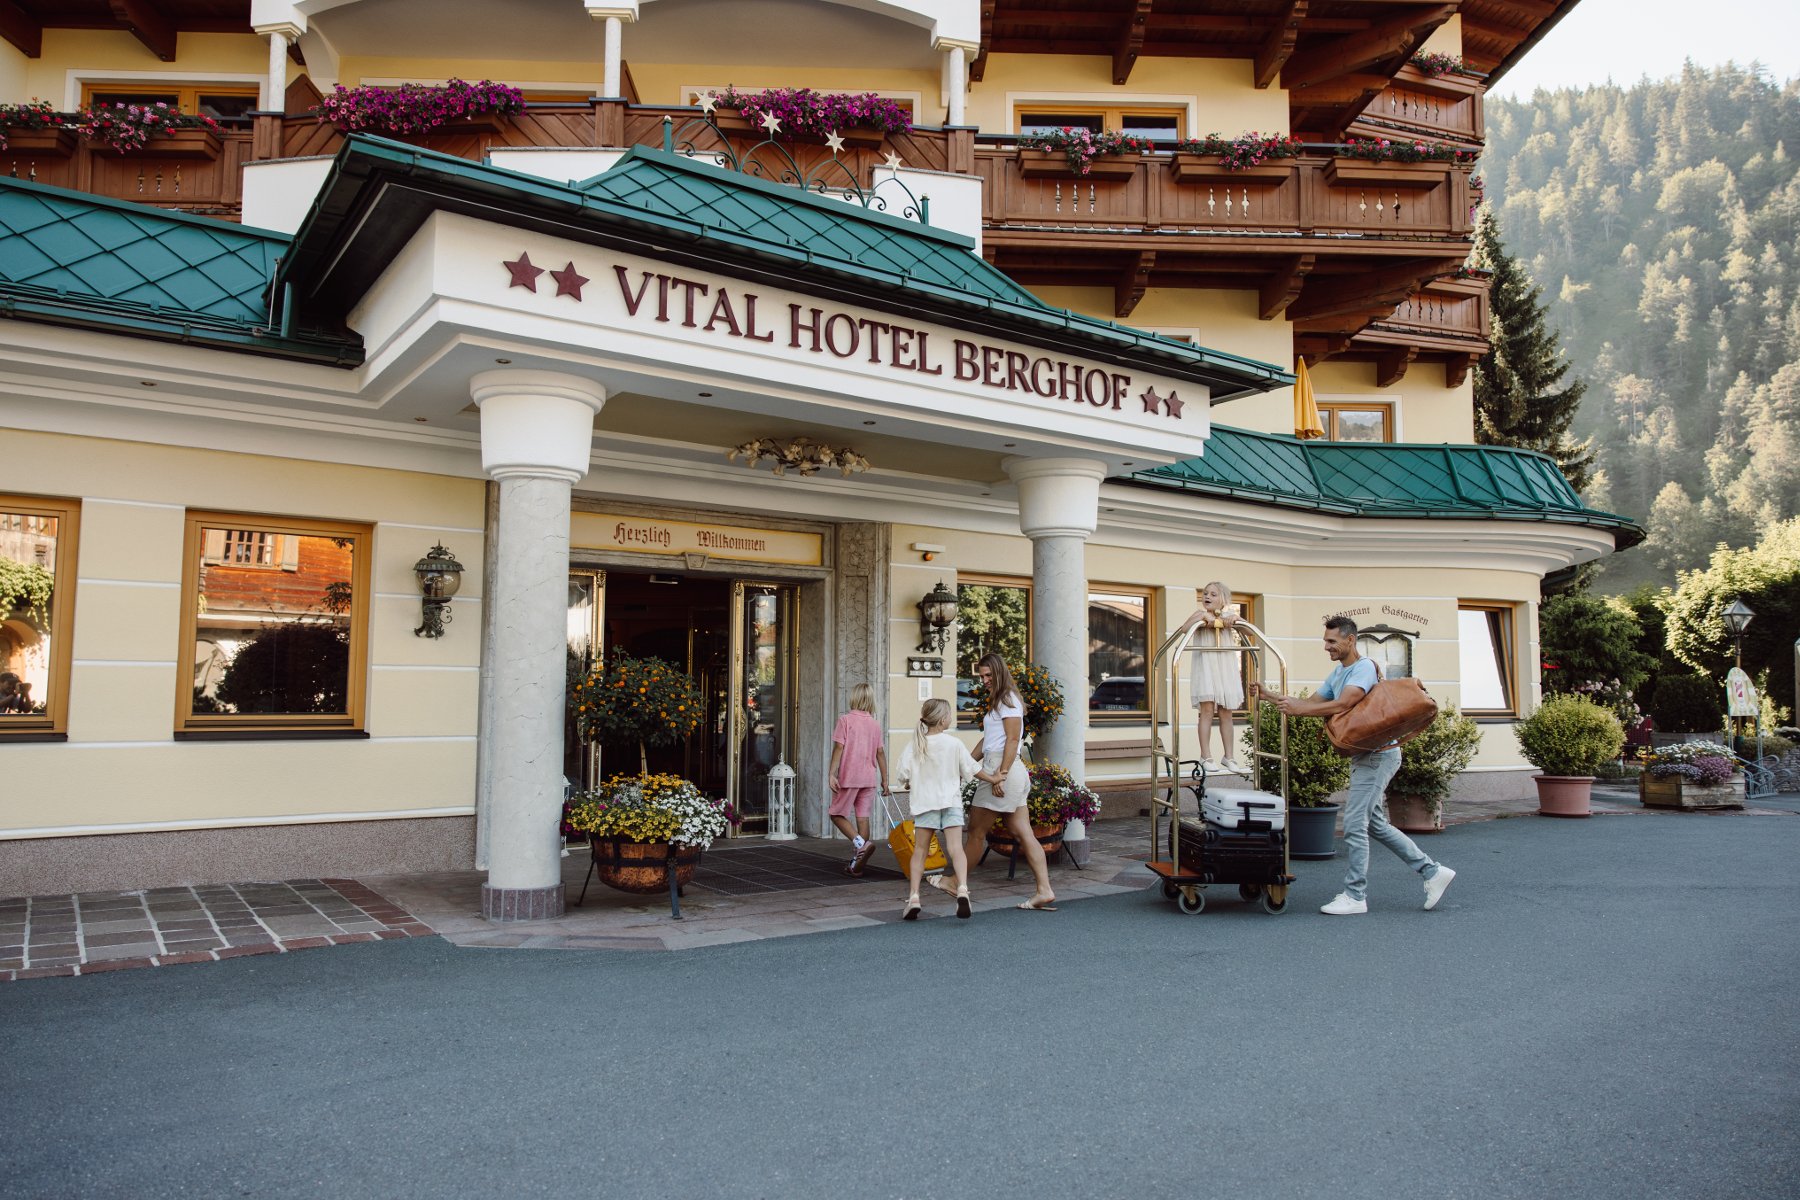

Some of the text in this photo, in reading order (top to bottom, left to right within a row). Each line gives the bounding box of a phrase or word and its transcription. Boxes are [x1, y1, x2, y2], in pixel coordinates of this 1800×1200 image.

[612, 264, 1131, 410] VITAL HOTEL BERGHOF
[613, 522, 765, 551] Herzlich Willkommen
[1381, 604, 1429, 626] Gastgarten
